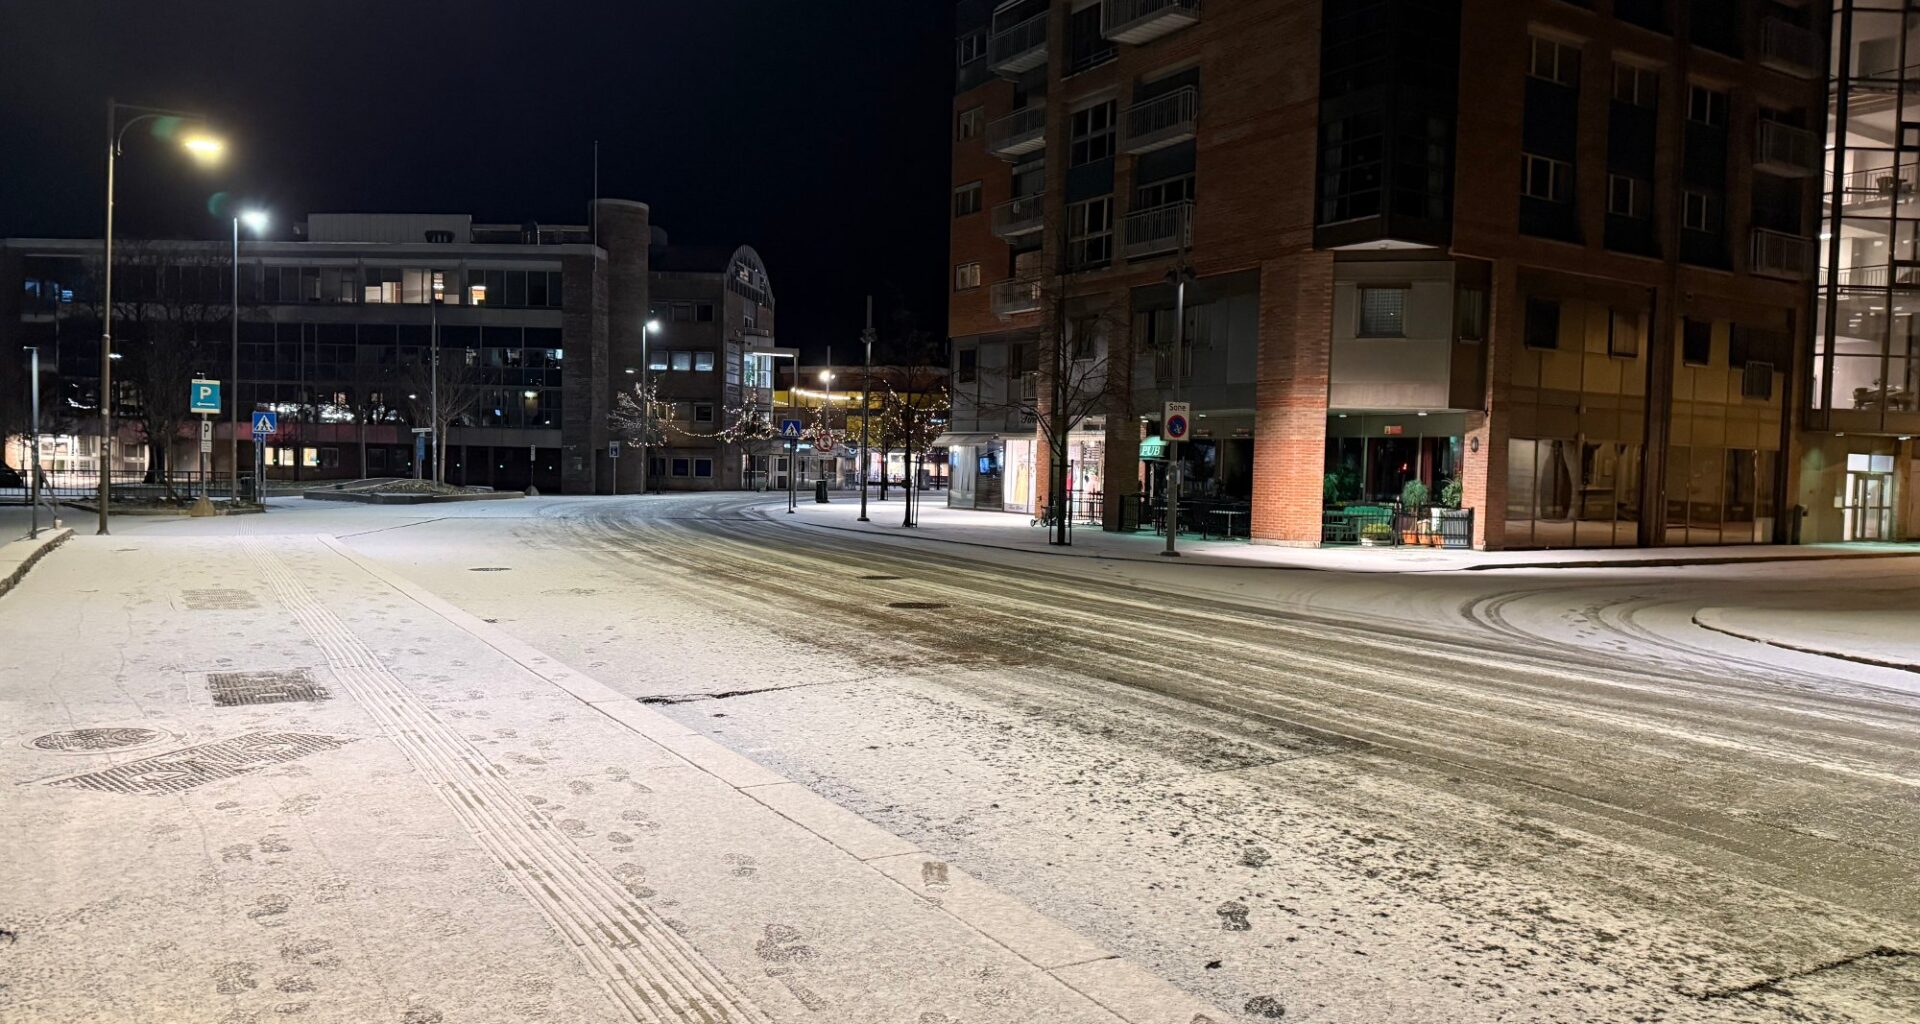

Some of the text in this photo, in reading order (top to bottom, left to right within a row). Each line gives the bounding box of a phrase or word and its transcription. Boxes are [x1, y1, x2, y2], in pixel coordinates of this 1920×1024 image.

[200, 386, 212, 400] P
[1168, 403, 1187, 411] Sone
[203, 423, 210, 438] P
[1140, 445, 1161, 456] PUB
